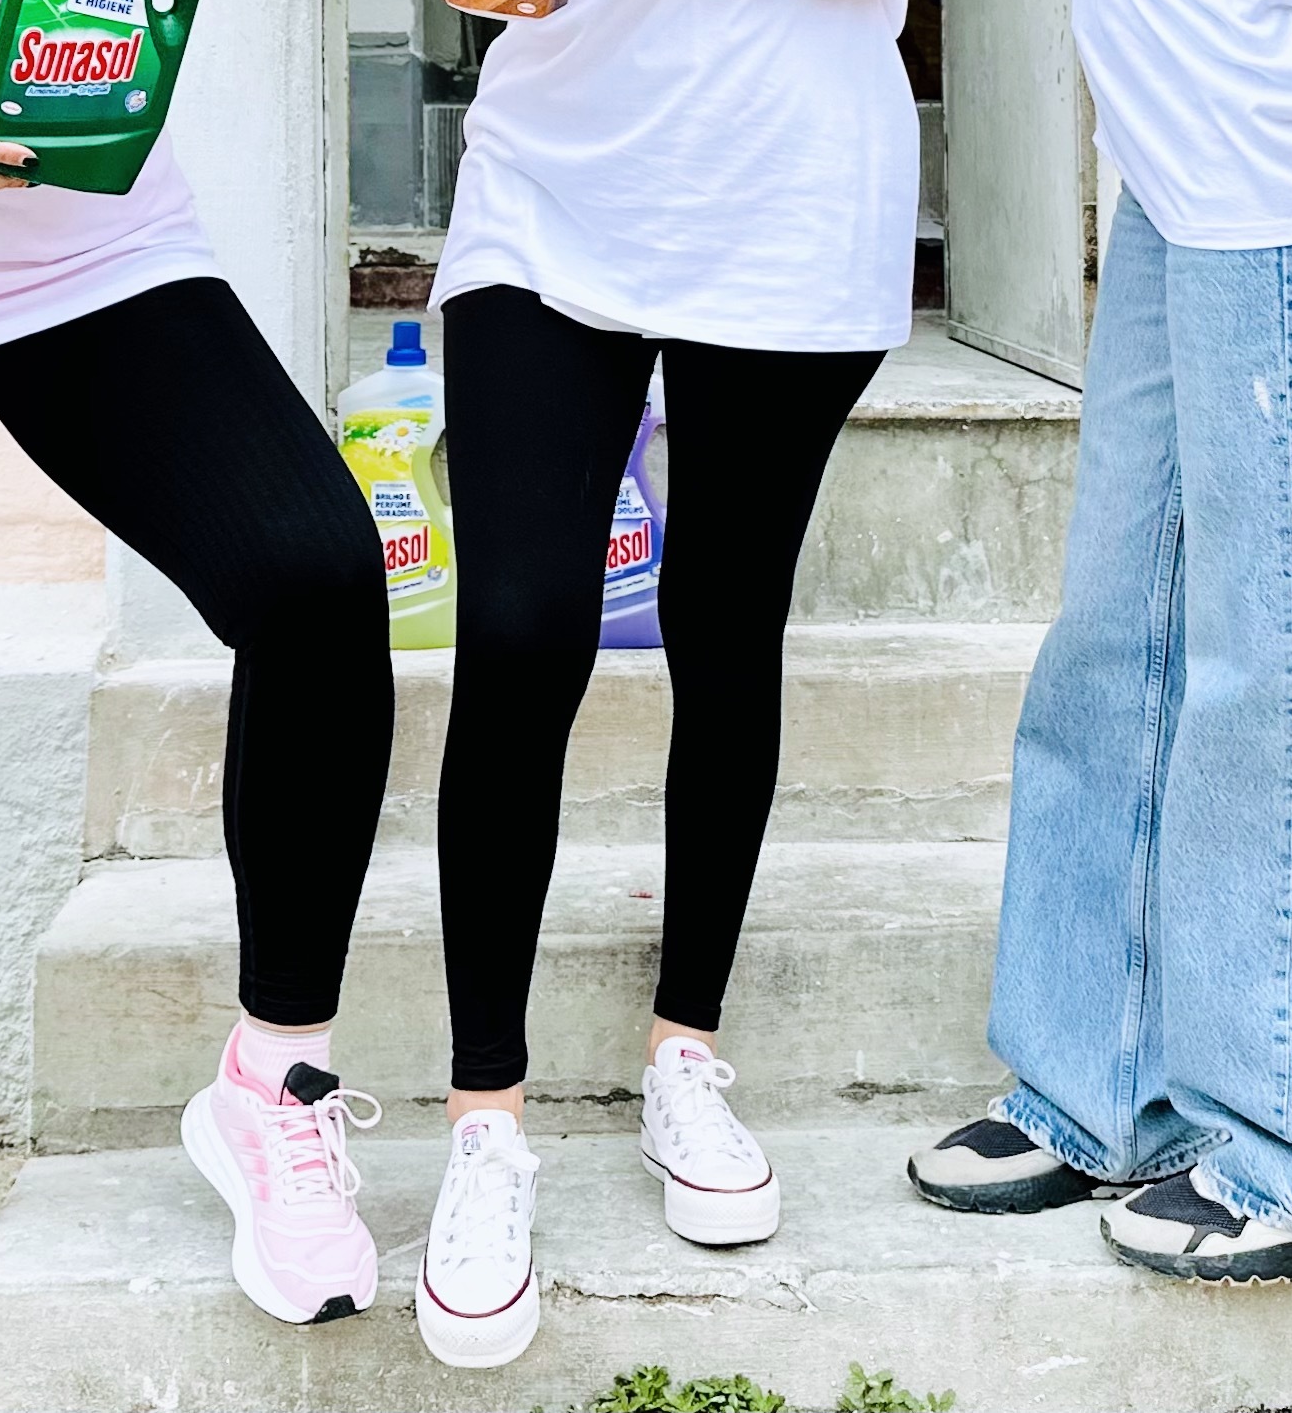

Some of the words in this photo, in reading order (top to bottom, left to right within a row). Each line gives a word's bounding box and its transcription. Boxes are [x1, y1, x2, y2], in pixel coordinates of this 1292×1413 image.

[14, 30, 143, 83] Sonasol
[375, 493, 404, 501] BRILHO
[375, 501, 412, 509] PERFUME
[385, 525, 428, 571] asol
[609, 522, 649, 569] asol
